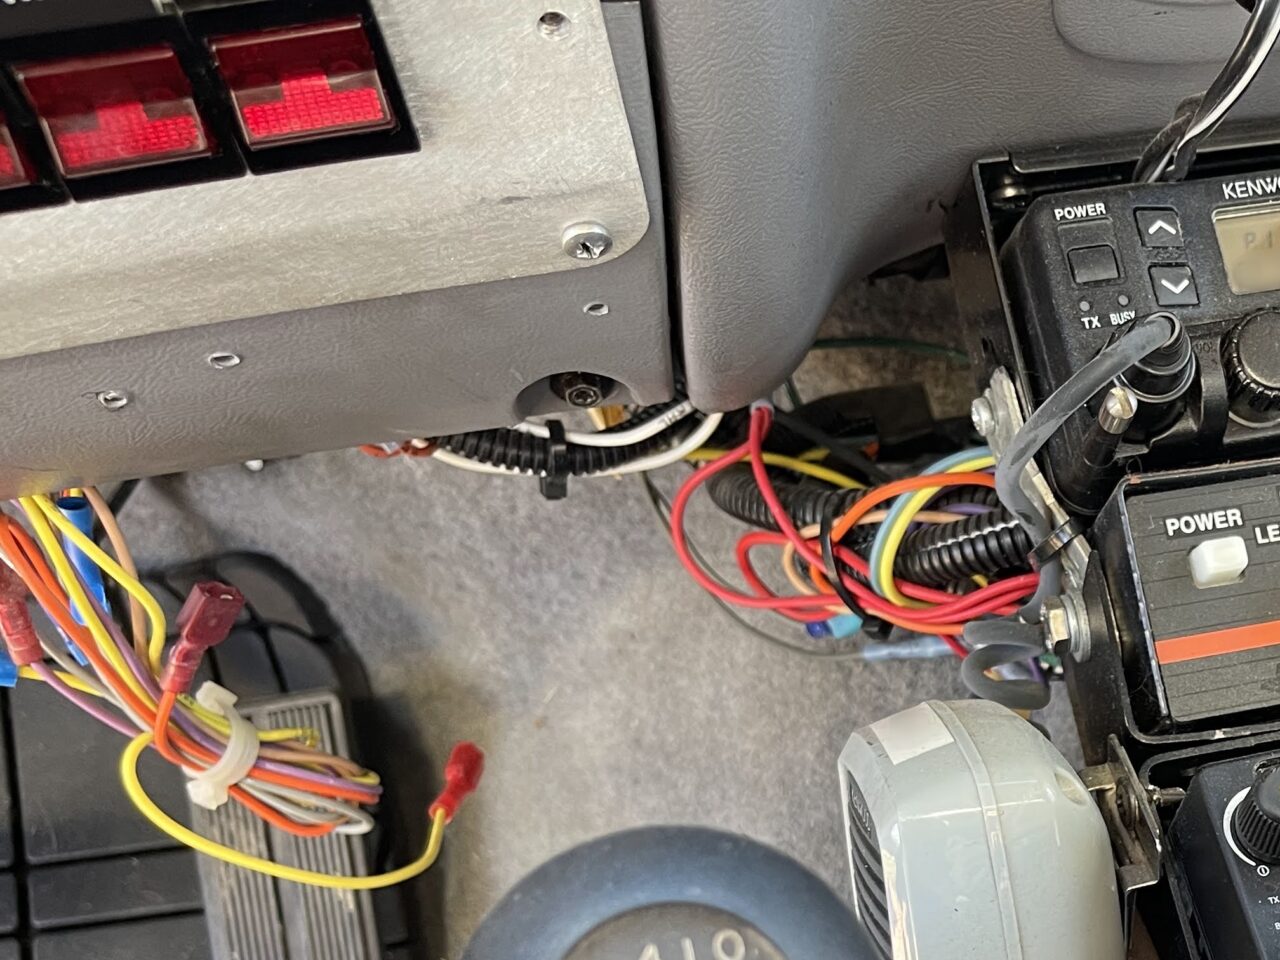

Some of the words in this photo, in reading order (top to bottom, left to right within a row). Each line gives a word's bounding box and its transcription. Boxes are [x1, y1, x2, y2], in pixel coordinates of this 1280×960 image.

[1054, 202, 1106, 221] POWER
[1080, 314, 1101, 329] TX
[1109, 310, 1136, 325] BUSY
[1165, 507, 1243, 538] POWER
[1267, 896, 1280, 904] TX
